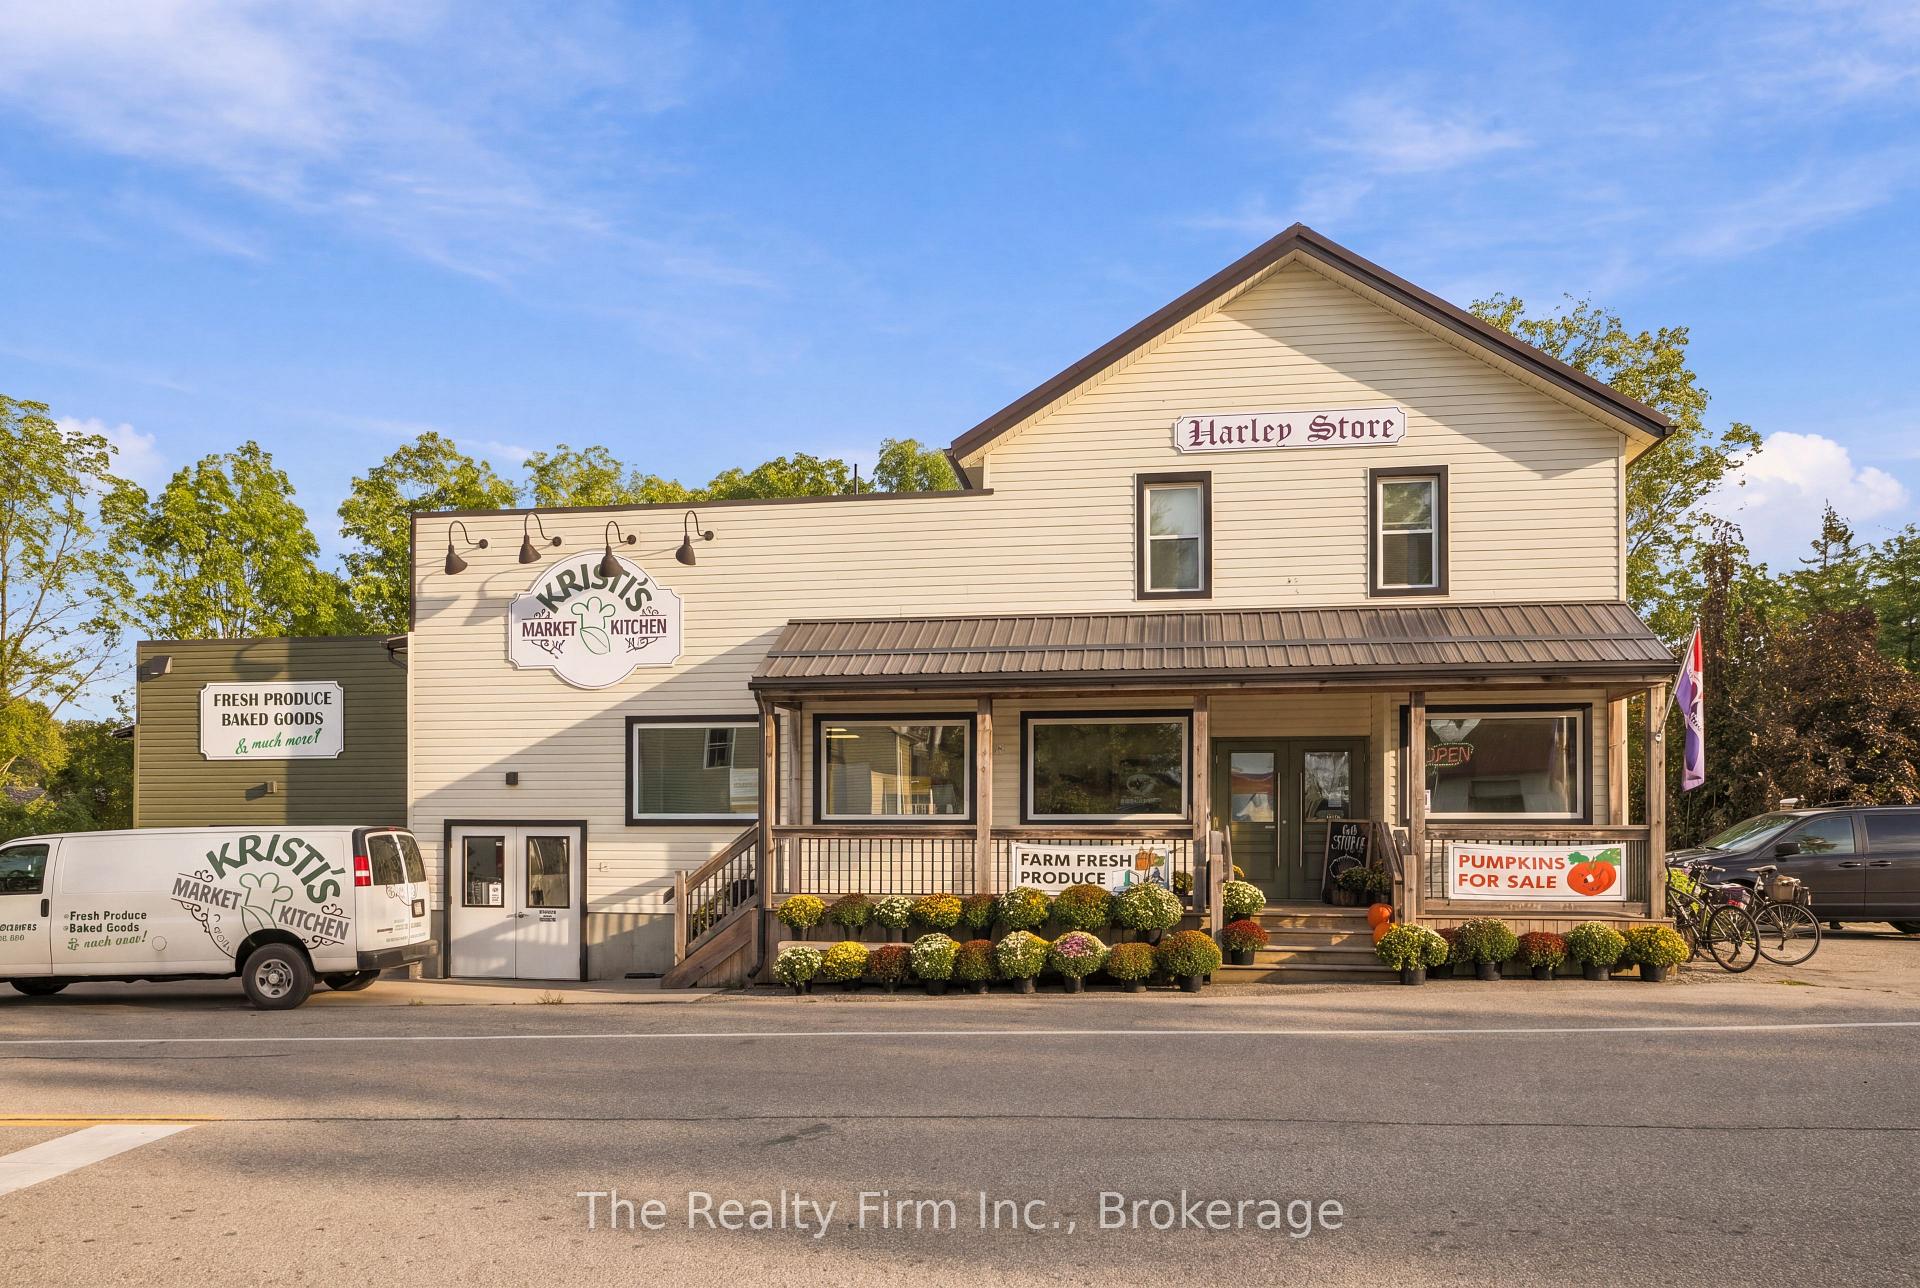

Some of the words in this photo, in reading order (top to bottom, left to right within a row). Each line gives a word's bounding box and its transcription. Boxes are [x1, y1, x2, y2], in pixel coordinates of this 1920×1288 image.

[1188, 418, 1293, 447] Harley
[1307, 414, 1395, 442] Store
[522, 620, 577, 637] MARKET
[610, 618, 667, 636] KITCHEN
[213, 693, 259, 707] FRESH
[264, 691, 332, 706] PRODUCE
[221, 712, 269, 726] BAKED
[274, 711, 324, 726] GOODS
[235, 738, 249, 755] &
[252, 731, 282, 750] much
[1020, 853, 1070, 867] FARM
[1076, 854, 1132, 868] FRESH
[1458, 854, 1565, 870] PUMPKINS
[206, 834, 346, 904] KRISTI'S
[1020, 871, 1106, 885] PRODUCE
[1458, 873, 1499, 888] FOR
[1507, 875, 1557, 889] SALE
[70, 911, 100, 920] Fresh
[104, 910, 147, 920] Produce
[172, 877, 242, 910] MARKET
[278, 905, 350, 940] KITCHEN
[69, 923, 103, 933] Baked
